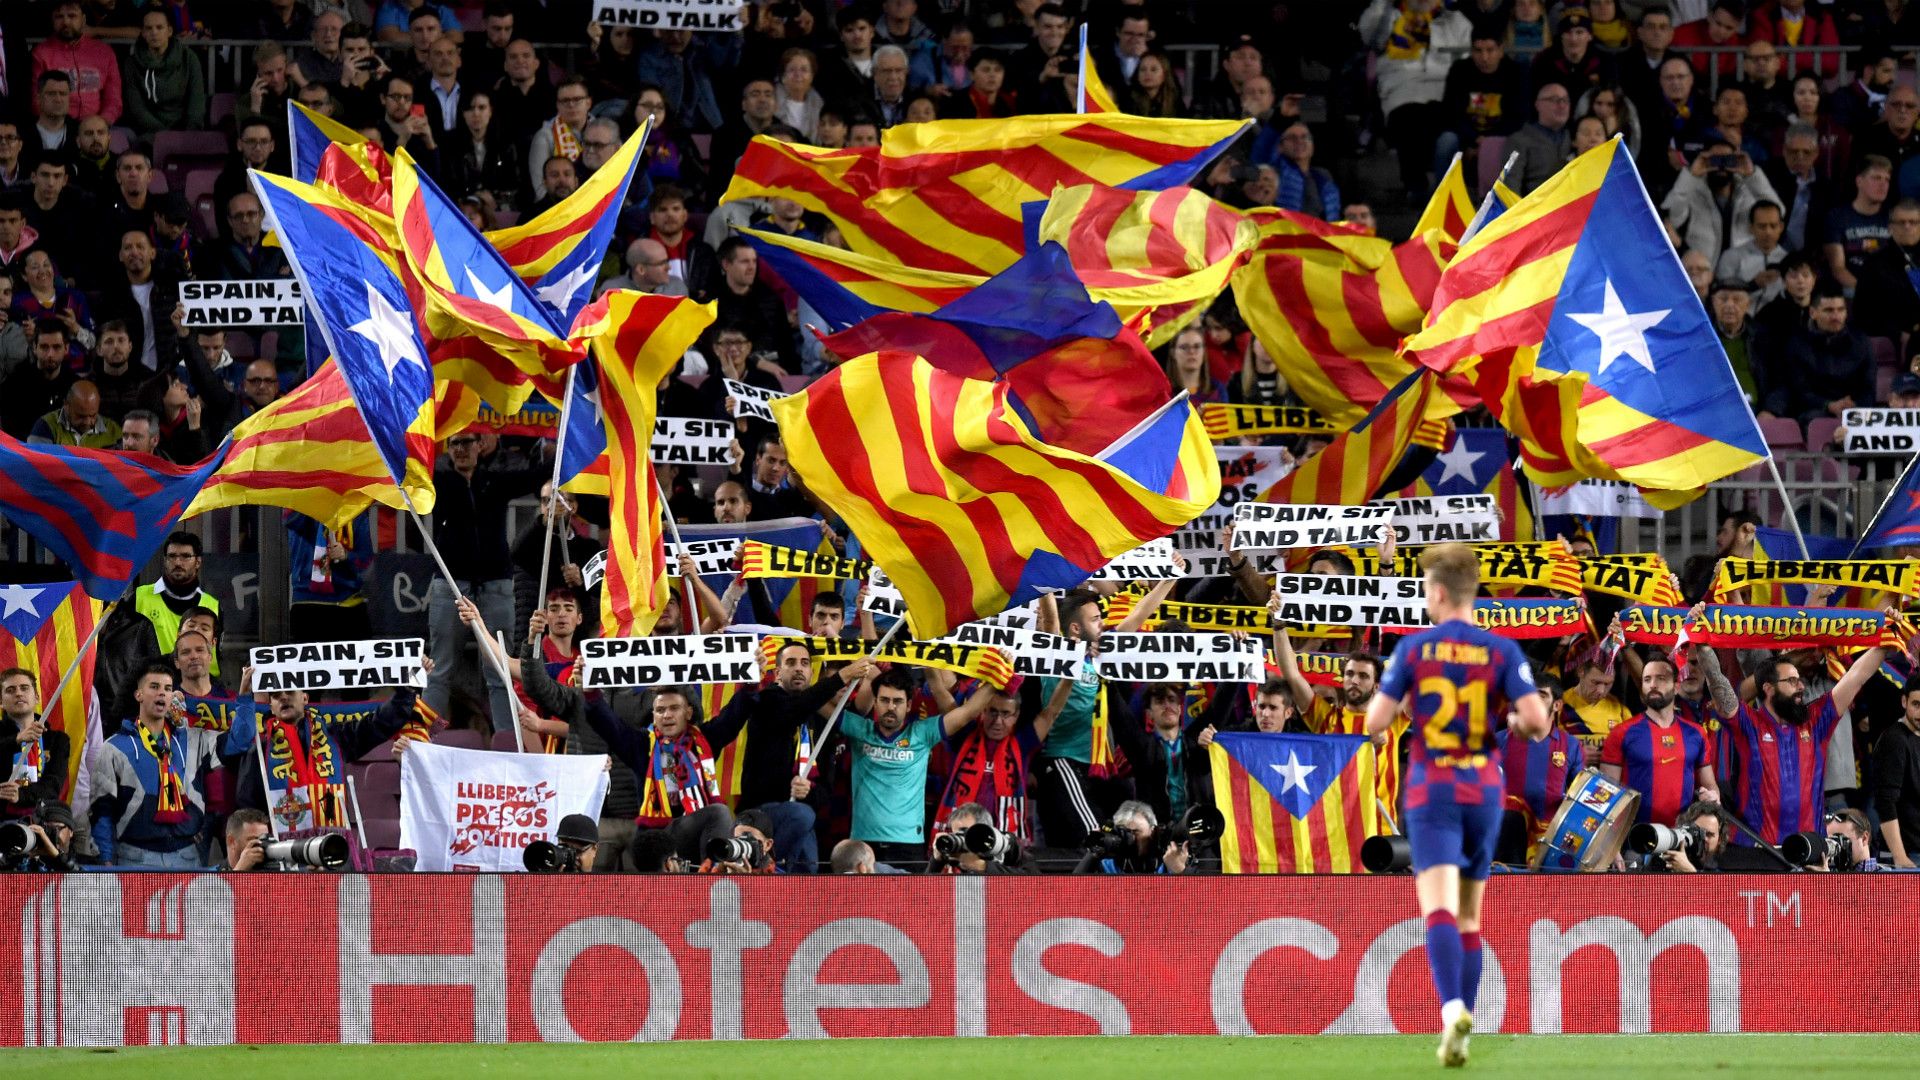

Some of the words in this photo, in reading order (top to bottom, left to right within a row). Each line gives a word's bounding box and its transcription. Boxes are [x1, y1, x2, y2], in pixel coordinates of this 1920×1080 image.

[599, 8, 659, 25] AND
[667, 12, 737, 28] TALK
[183, 282, 283, 301] SPAIN,
[187, 307, 253, 324] AND
[260, 307, 303, 323] TA
[728, 381, 789, 402] SPA
[740, 400, 774, 420] AN
[1846, 411, 1920, 427] SPAI
[685, 420, 730, 438] SIT
[1849, 435, 1913, 450] AND
[650, 444, 730, 463] TALK
[1236, 505, 1332, 523] SPAIN,
[1341, 507, 1391, 519] SIT
[1446, 496, 1492, 512] SIT
[1233, 529, 1299, 548] AND
[1307, 524, 1384, 543] TALK
[1417, 522, 1493, 542] TALK
[688, 540, 734, 556] SIT
[770, 546, 873, 580] LLIBER
[1111, 565, 1178, 579] TALK
[1725, 560, 1911, 587] LLIBERTAT
[1280, 576, 1388, 600] SPAIN,
[869, 596, 907, 616] AN
[1280, 603, 1352, 622] AND
[585, 638, 695, 658] SPAIN,
[703, 636, 753, 654] SIT
[784, 637, 978, 667] LIBERTAT
[1031, 633, 1077, 651] SIT
[1100, 635, 1204, 655] SPAIN,
[1211, 635, 1258, 654] SIT
[255, 643, 365, 664] SPAIN,
[373, 641, 421, 659] SIT
[589, 665, 662, 685] AND
[669, 662, 753, 682] TALK
[1013, 656, 1077, 678] ALK
[1100, 662, 1169, 680] AND
[1177, 662, 1258, 680] TALK
[258, 670, 331, 690] AND
[339, 666, 422, 686] TALK
[1420, 675, 1488, 751] 21
[863, 743, 914, 761] Rakuten
[457, 782, 547, 803] LLIBERTAT
[456, 803, 548, 828] PRESOS
[1739, 890, 1801, 928] TM
